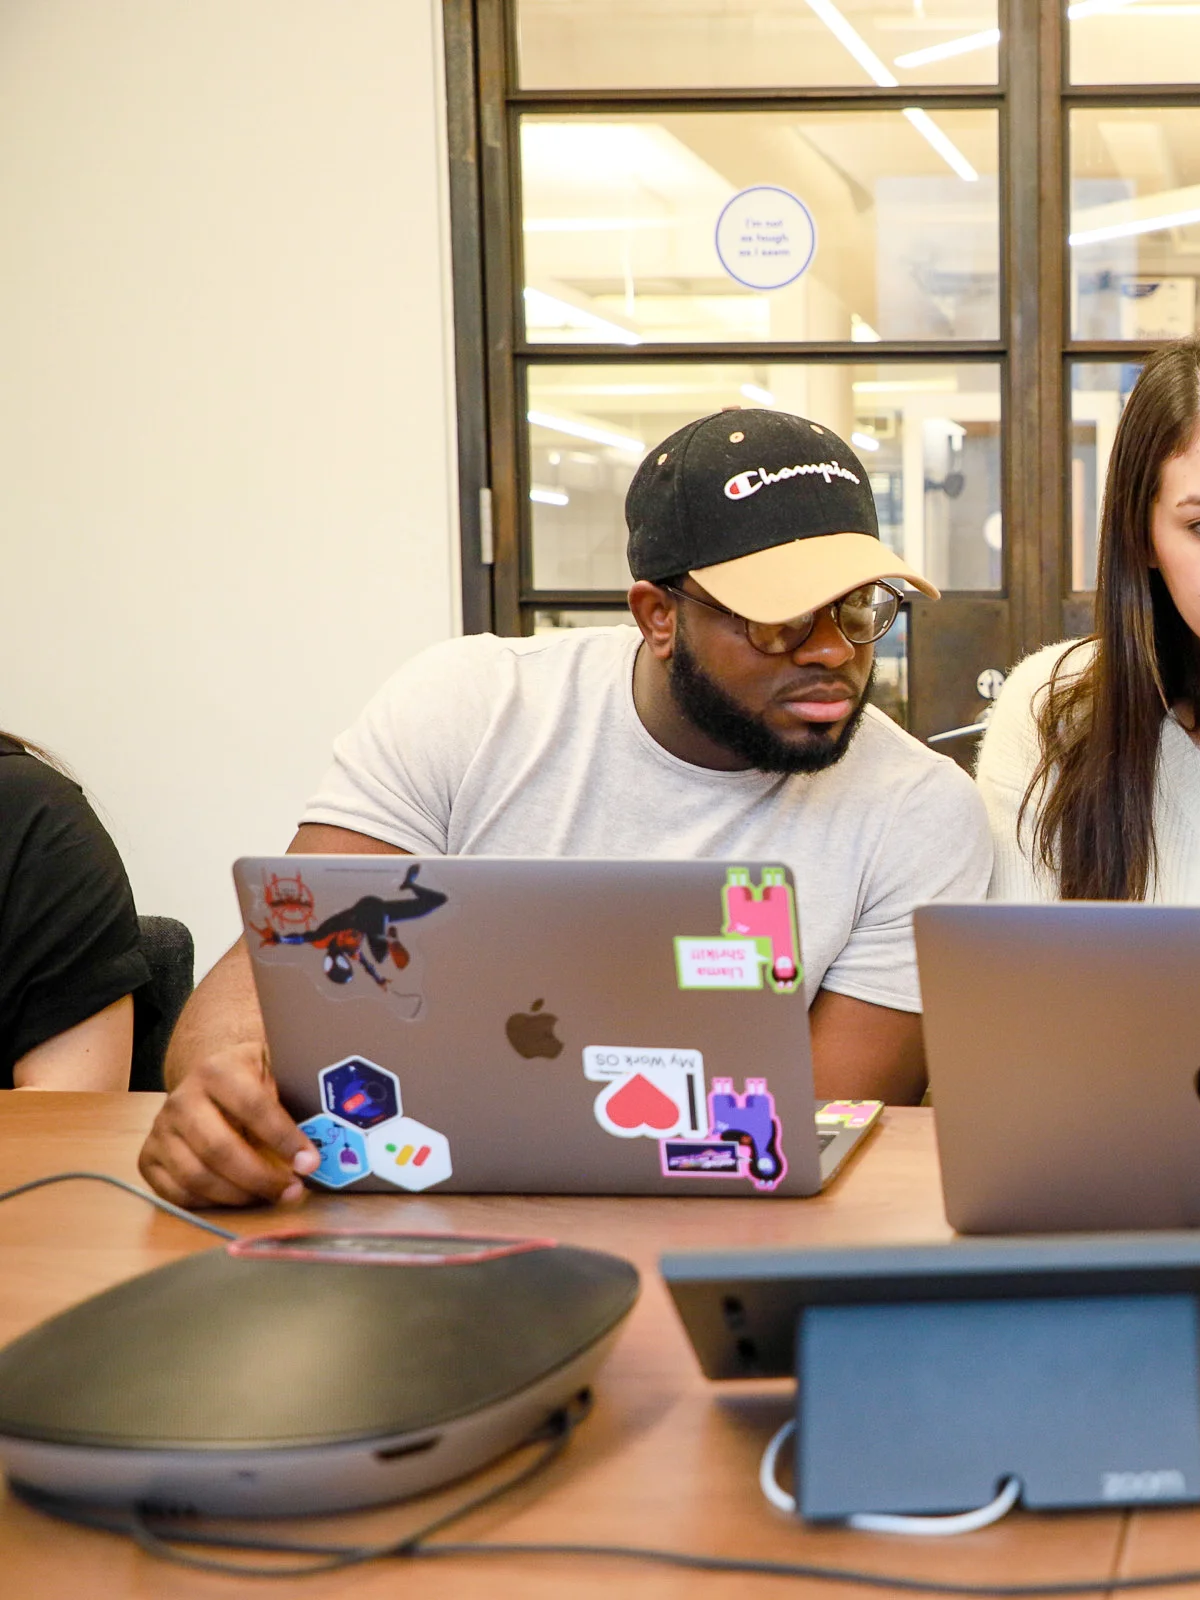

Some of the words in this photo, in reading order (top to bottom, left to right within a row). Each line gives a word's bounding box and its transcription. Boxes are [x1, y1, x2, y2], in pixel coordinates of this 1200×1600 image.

[696, 966, 744, 979] Llama
[595, 1053, 620, 1067] OS
[624, 1054, 666, 1068] Work
[670, 1054, 696, 1069] My
[686, 1073, 699, 1131] I
